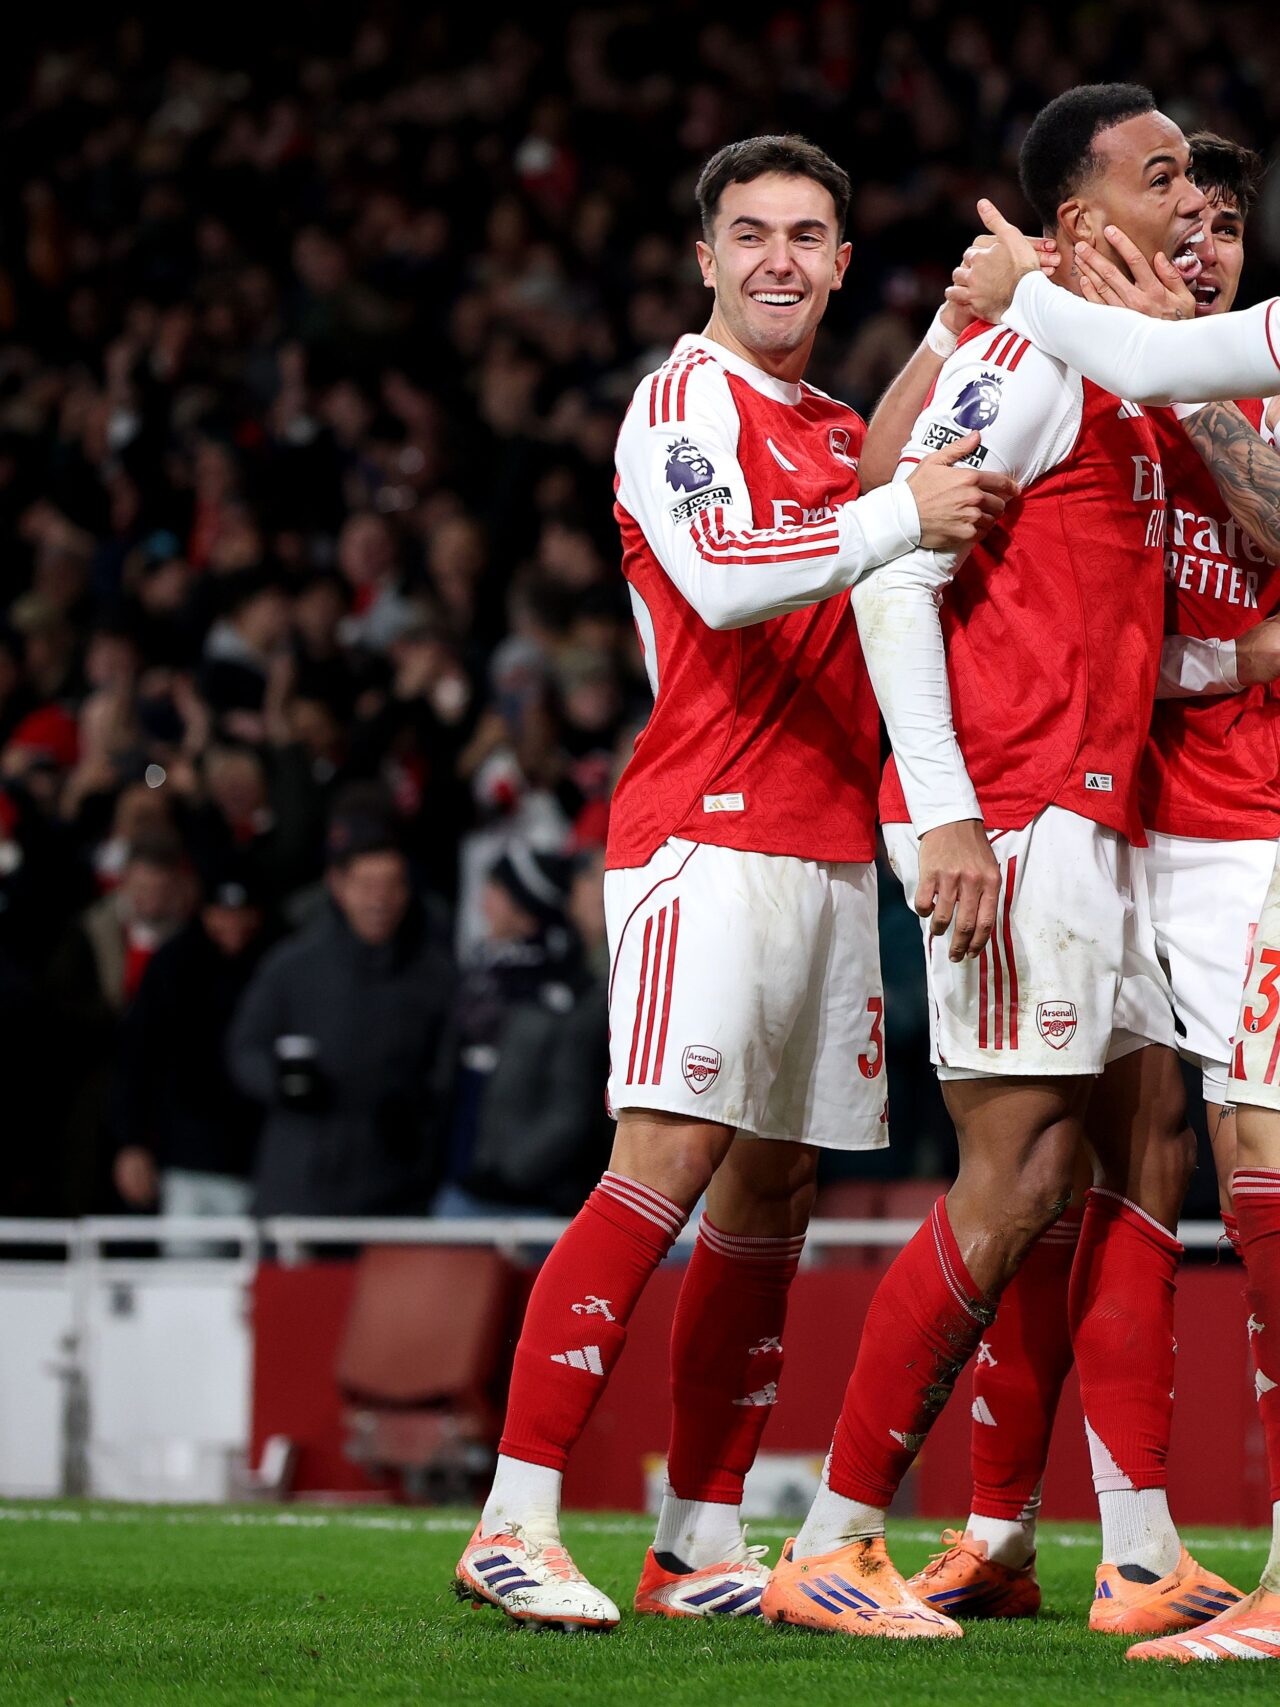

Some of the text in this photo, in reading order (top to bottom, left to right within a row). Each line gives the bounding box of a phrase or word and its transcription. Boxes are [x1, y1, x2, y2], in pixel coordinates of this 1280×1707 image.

[689, 489, 725, 507] room
[1164, 550, 1258, 609] BETTER
[1042, 1009, 1072, 1017] Arsenal
[688, 1052, 717, 1065] Arsenal
